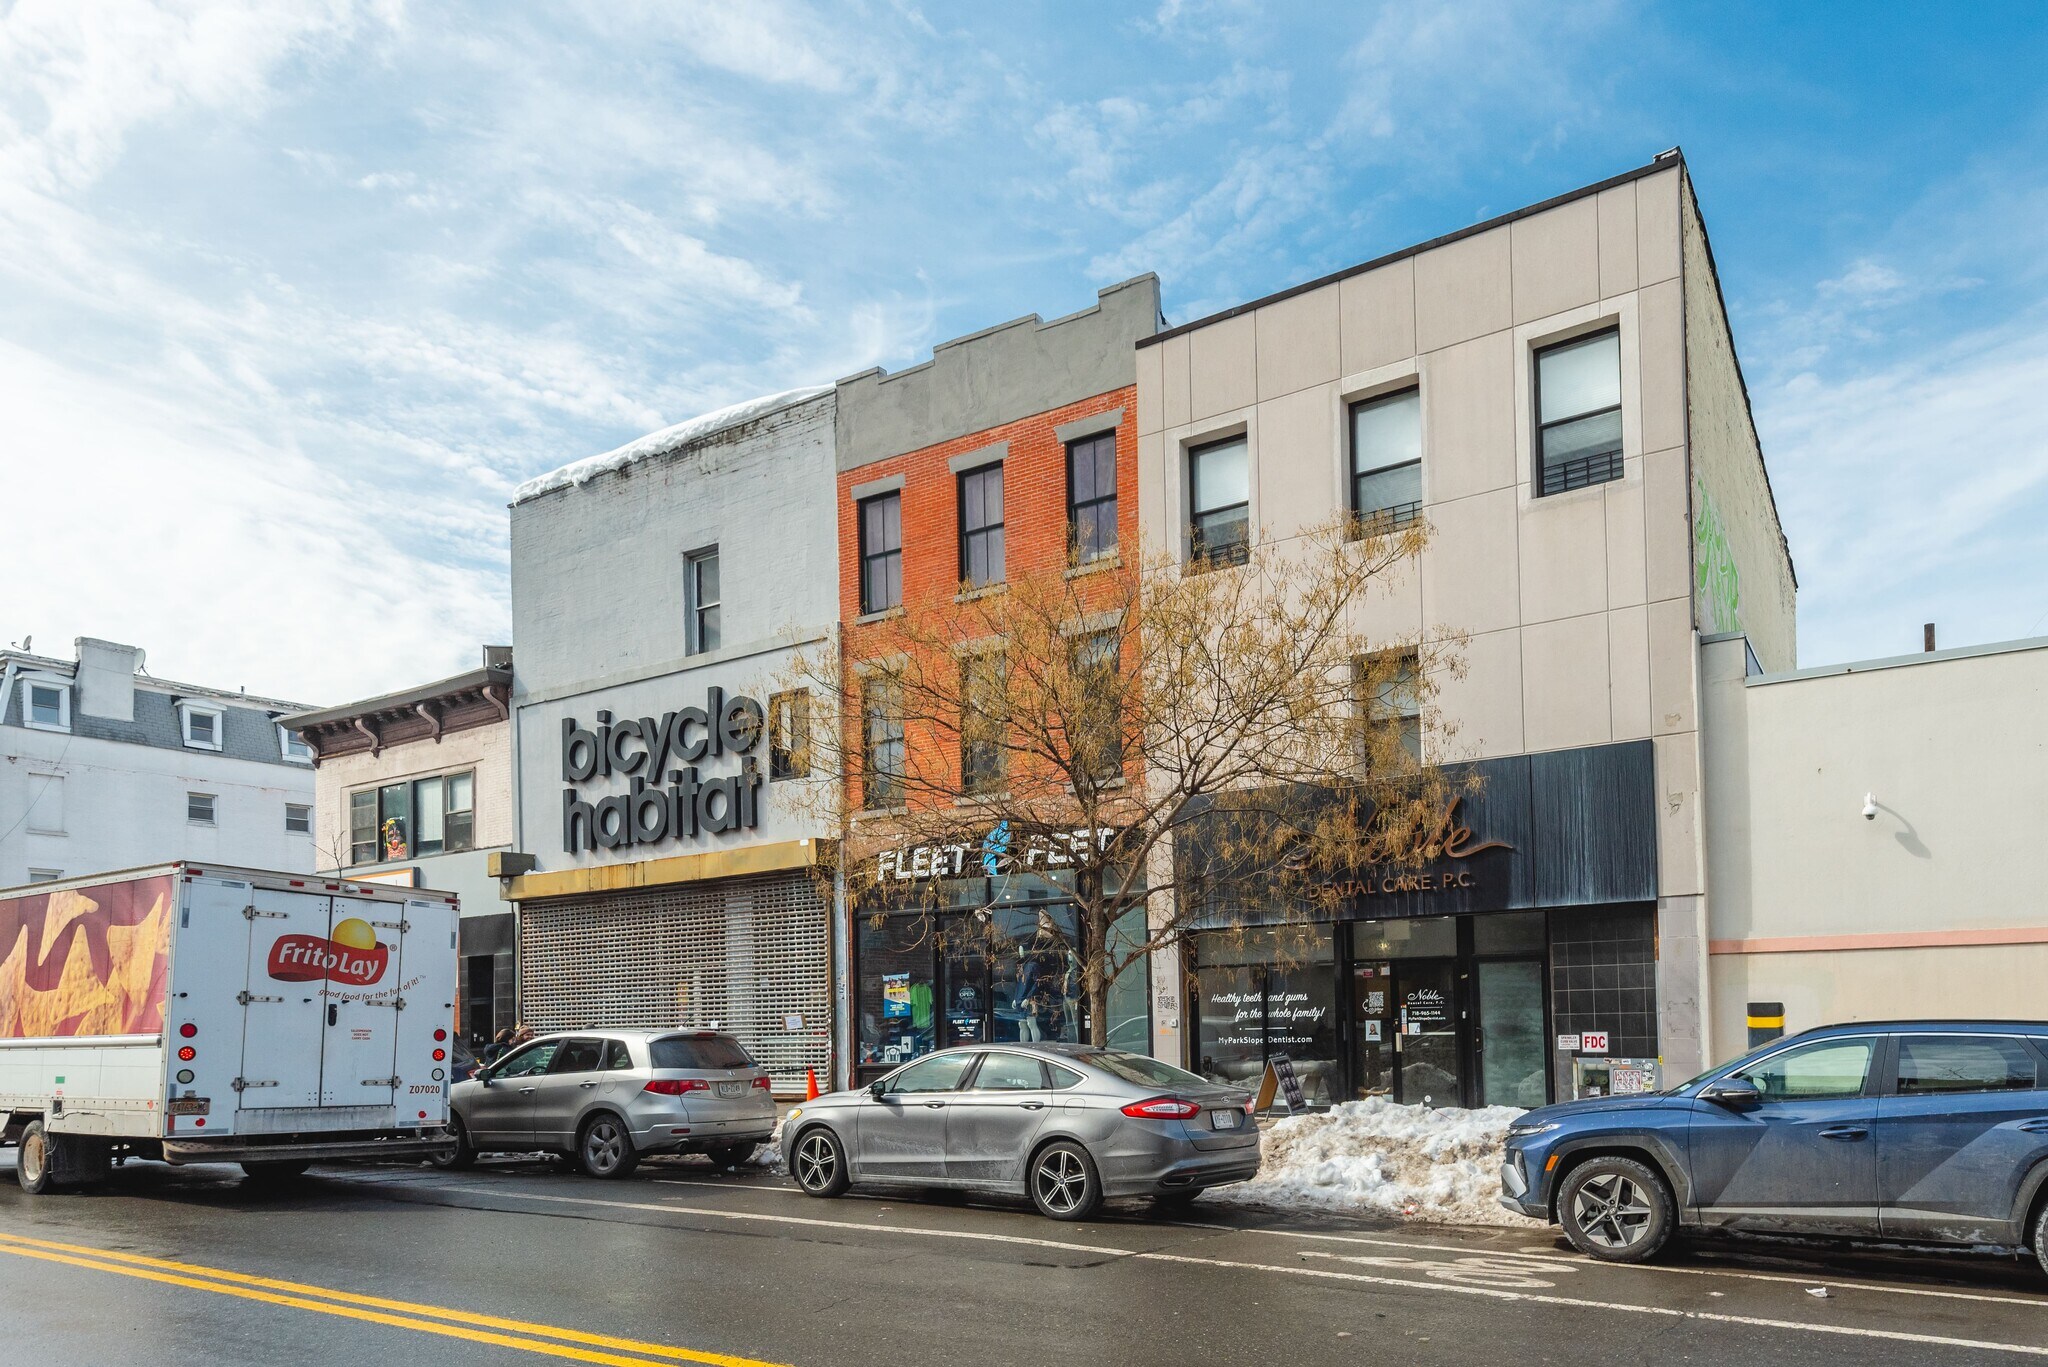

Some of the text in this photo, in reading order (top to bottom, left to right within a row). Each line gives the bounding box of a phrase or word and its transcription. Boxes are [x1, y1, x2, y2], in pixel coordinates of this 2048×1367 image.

[562, 686, 764, 784] bicycle
[563, 756, 763, 853] habitat
[878, 842, 971, 881] FLEET
[1308, 879, 1376, 899] DENTAL
[1442, 872, 1476, 888] P.C.
[279, 942, 380, 981] Frito Lay
[318, 978, 420, 1002] good food for the fun of it!
[1211, 991, 1308, 1007] Healthy teeth and gums
[1407, 989, 1444, 1000] Noble
[1235, 1006, 1326, 1022] for the whole family!
[1584, 1036, 1606, 1048] FDC
[409, 1085, 440, 1094] Z07020
